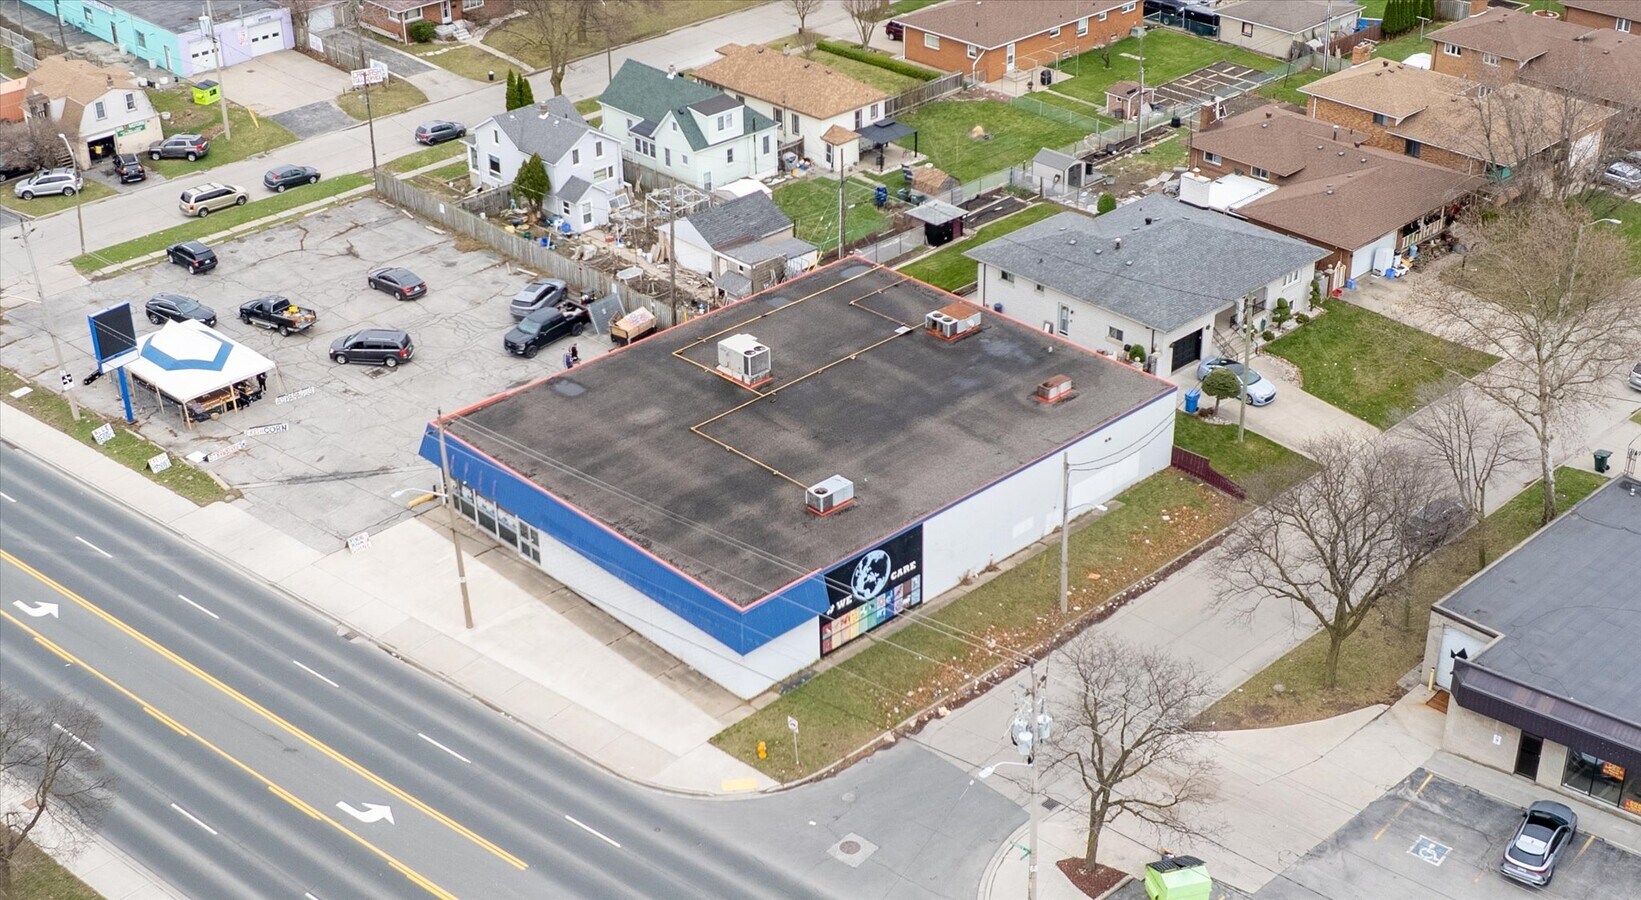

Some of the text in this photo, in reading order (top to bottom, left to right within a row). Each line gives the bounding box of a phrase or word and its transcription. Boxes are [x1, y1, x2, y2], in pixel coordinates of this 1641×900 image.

[263, 424, 287, 434] CORN
[836, 595, 853, 612] WE
[890, 561, 917, 580] CARE
